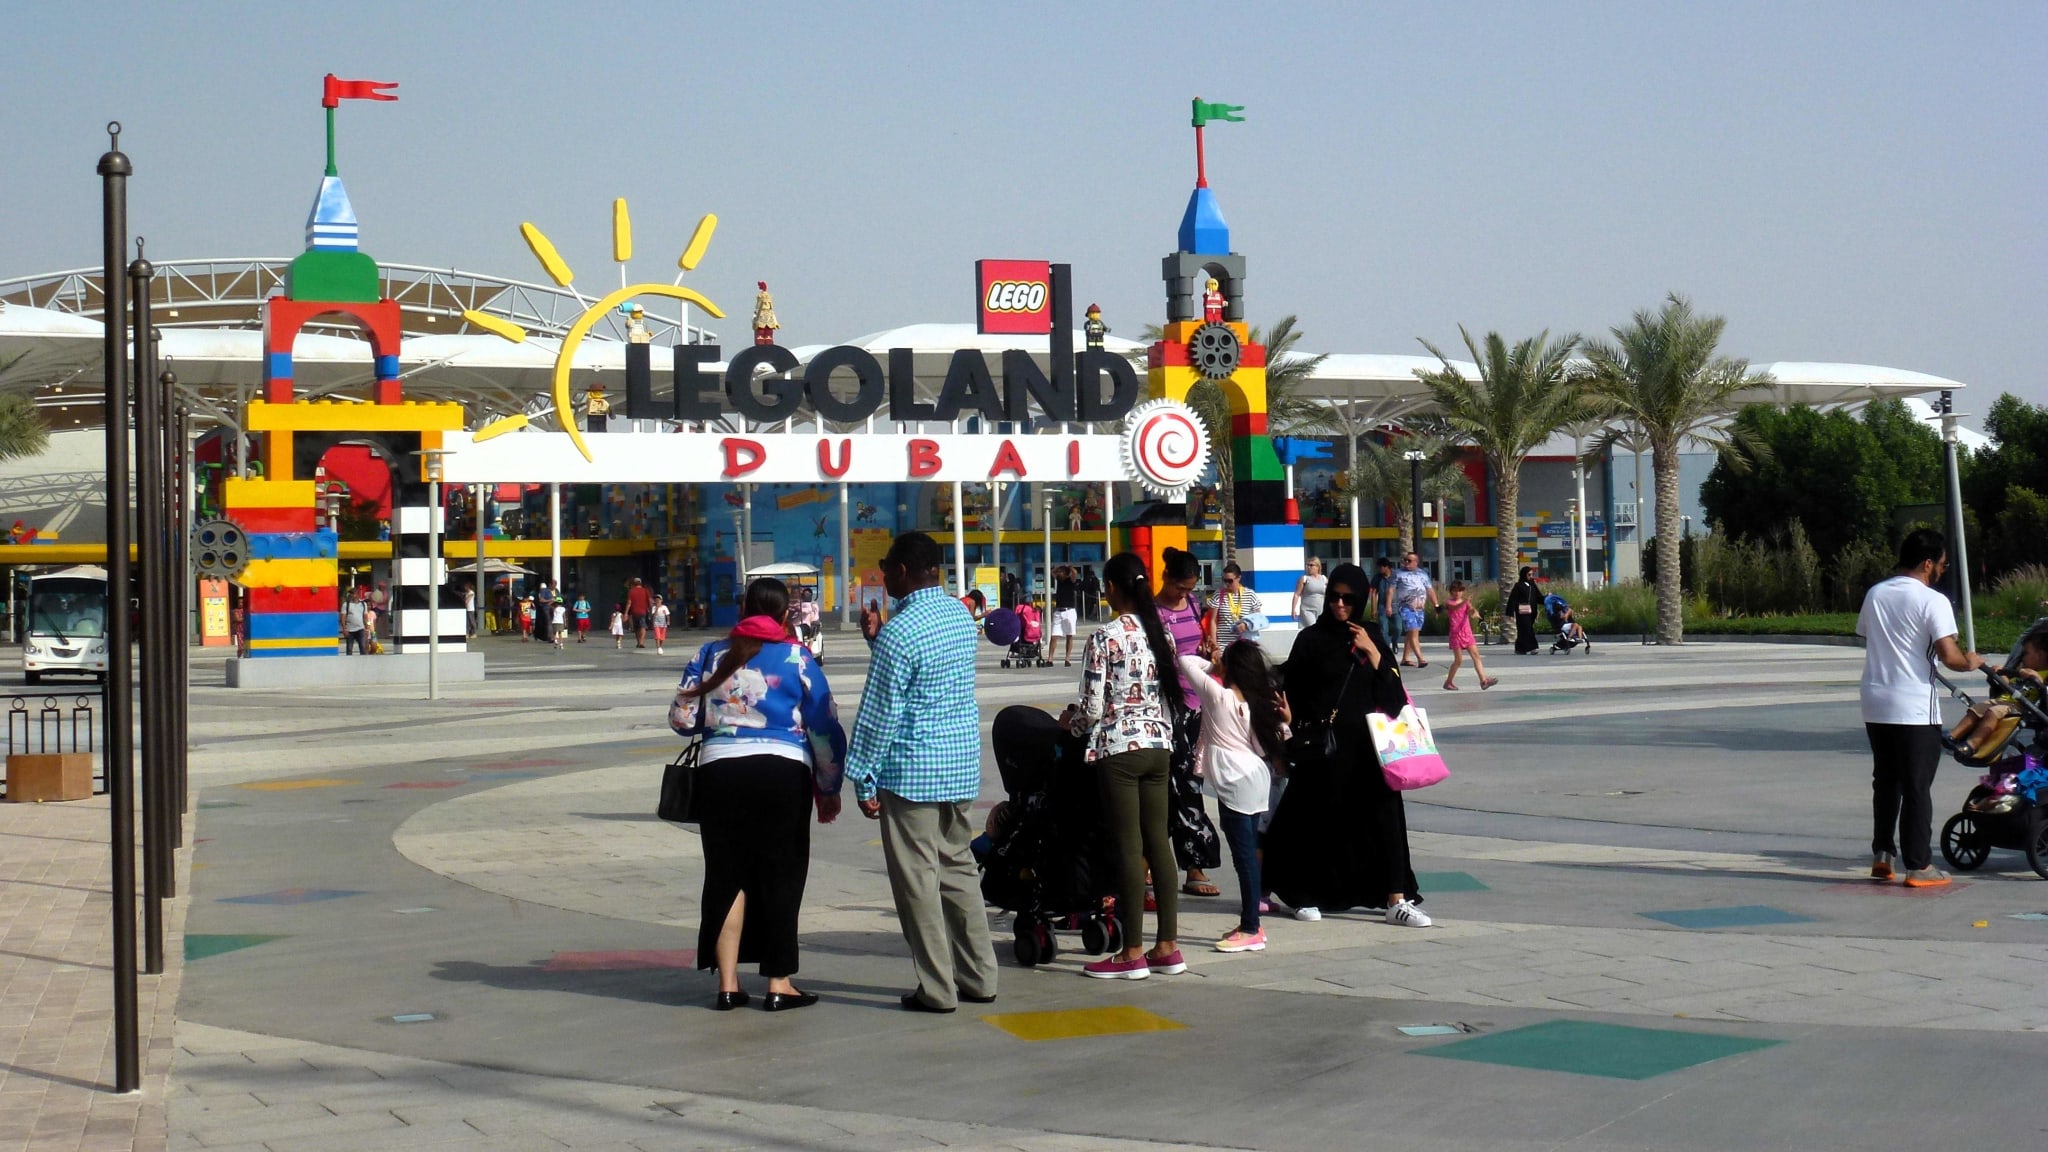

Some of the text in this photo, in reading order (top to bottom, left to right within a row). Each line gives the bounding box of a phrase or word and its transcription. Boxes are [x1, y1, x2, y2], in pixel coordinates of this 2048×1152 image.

[988, 283, 1046, 311] LEGO
[625, 264, 1139, 423] LEGOLAND
[720, 436, 1080, 478] DUBAI
